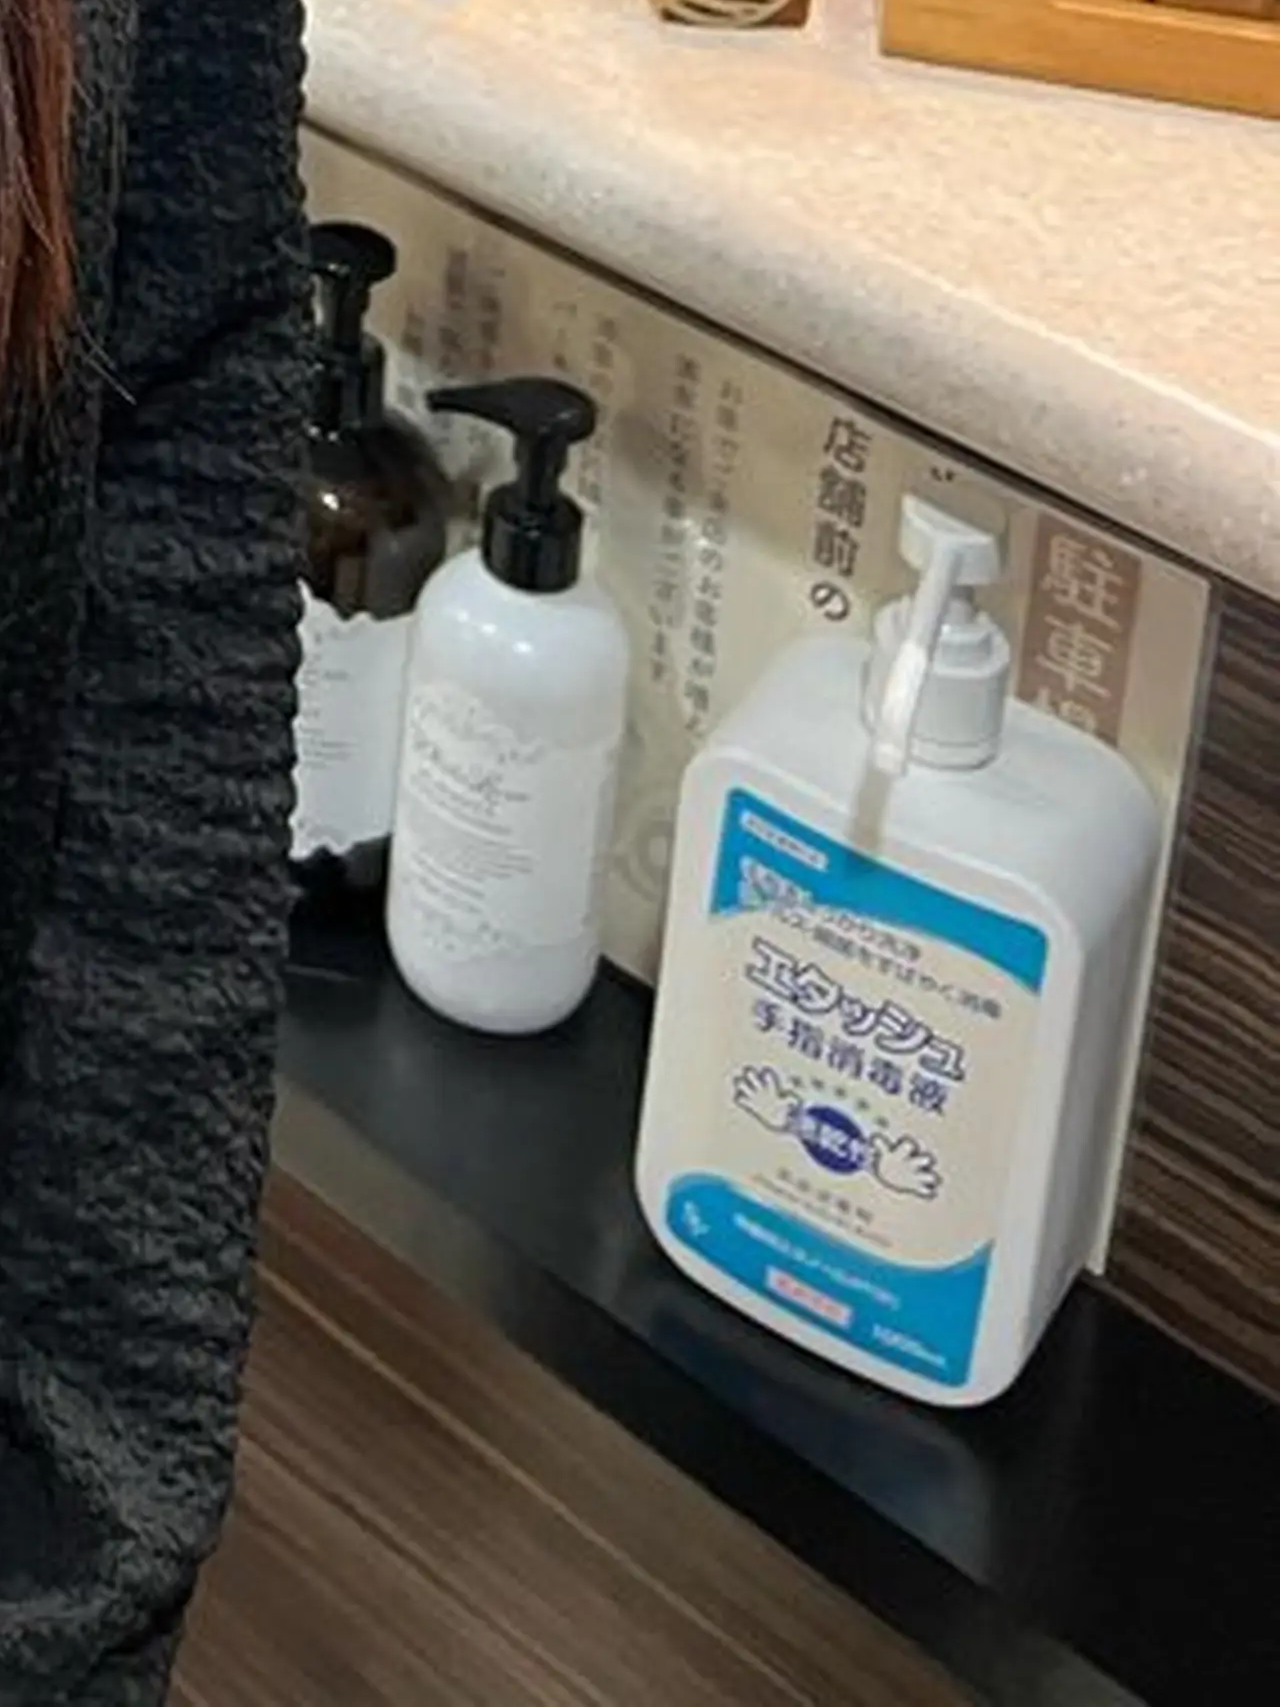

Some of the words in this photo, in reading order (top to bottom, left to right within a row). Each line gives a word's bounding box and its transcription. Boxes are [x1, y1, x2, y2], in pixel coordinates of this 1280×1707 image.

[808, 415, 872, 623] 店舗前の
[744, 934, 967, 1085] エタッシュ
[752, 997, 948, 1117] 手指消毒液
